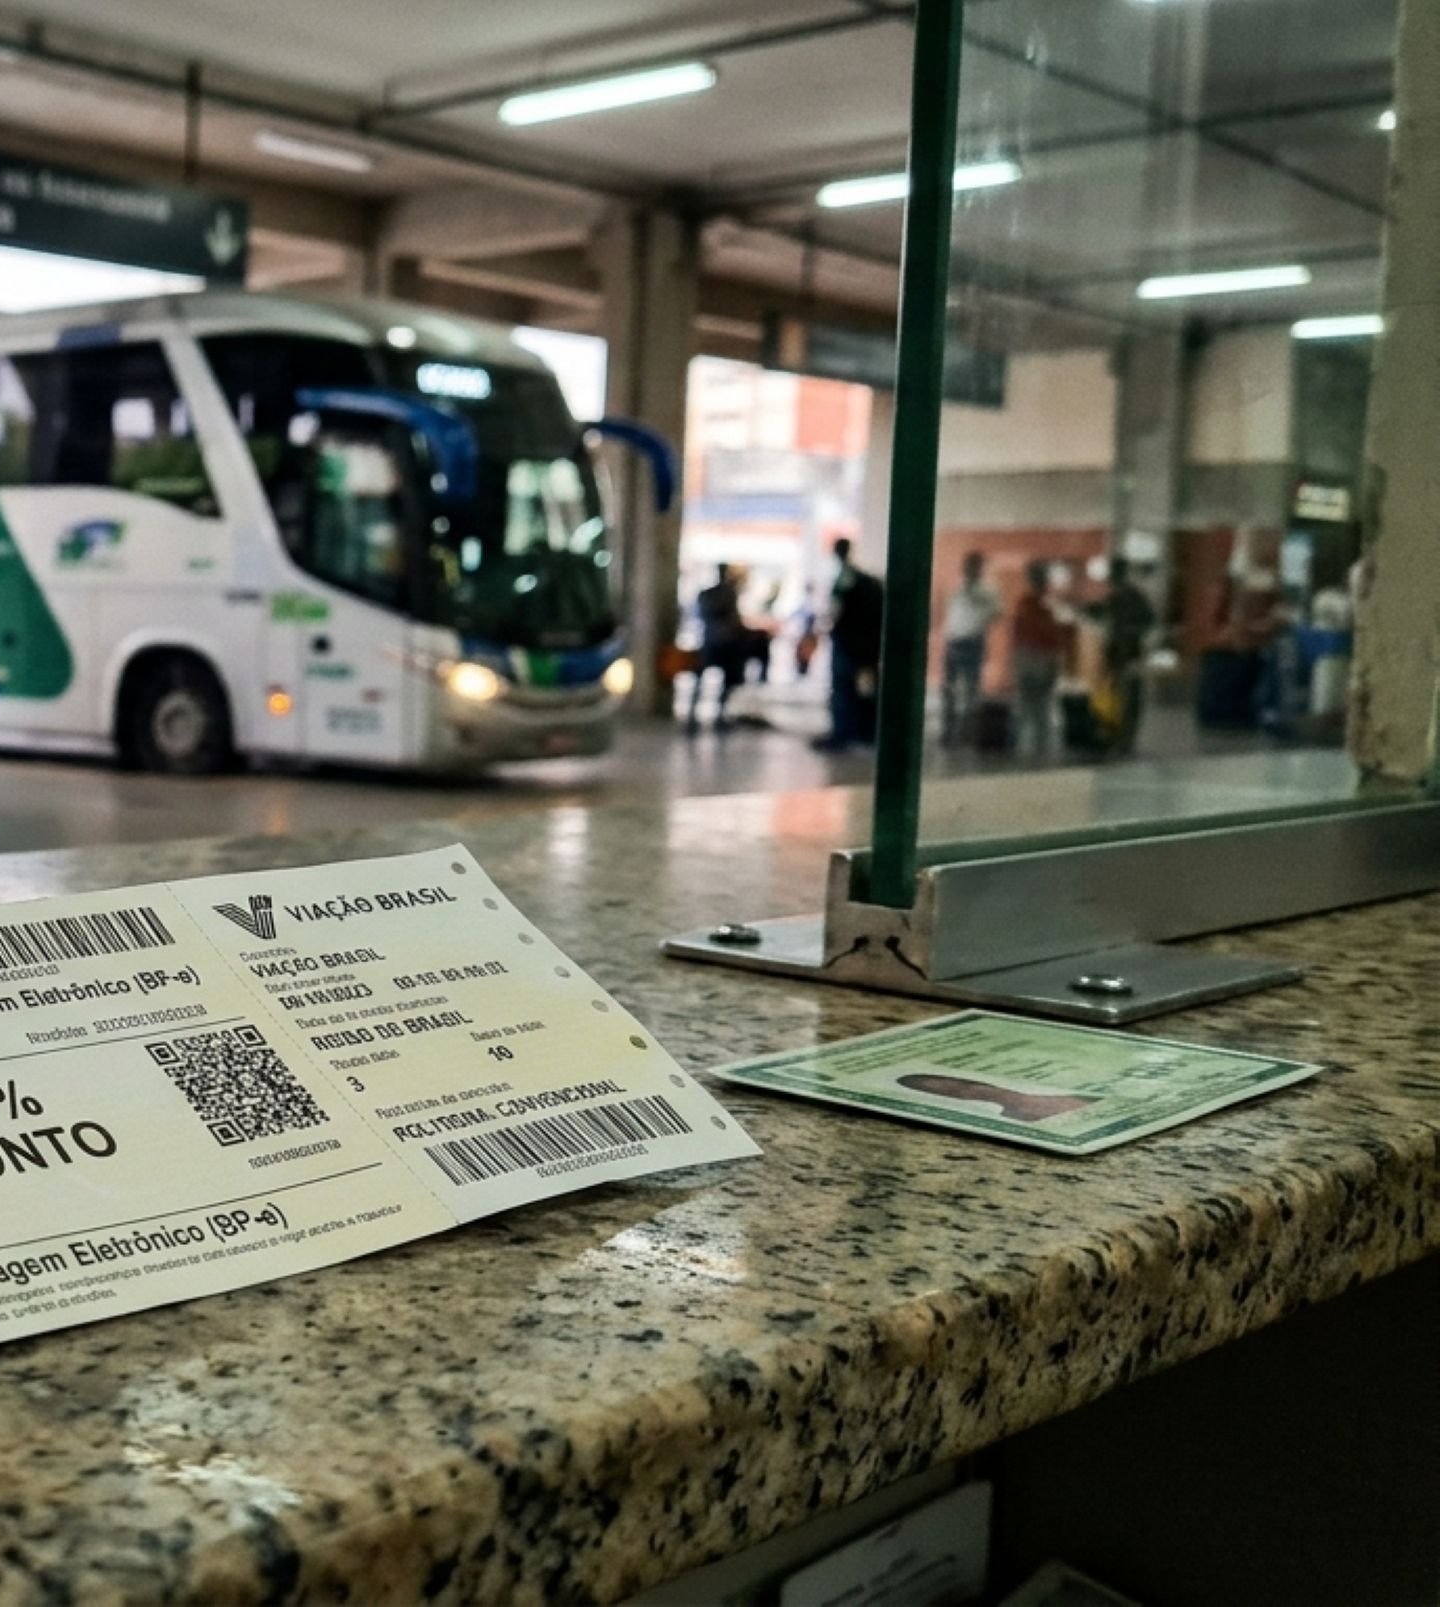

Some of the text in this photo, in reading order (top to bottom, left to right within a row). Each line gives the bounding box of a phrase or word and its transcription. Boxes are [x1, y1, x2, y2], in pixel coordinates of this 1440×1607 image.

[283, 886, 457, 921] VIAÇÃO BRASIL
[346, 1075, 366, 1093] 3
[68, 1225, 205, 1267] Eletrônico
